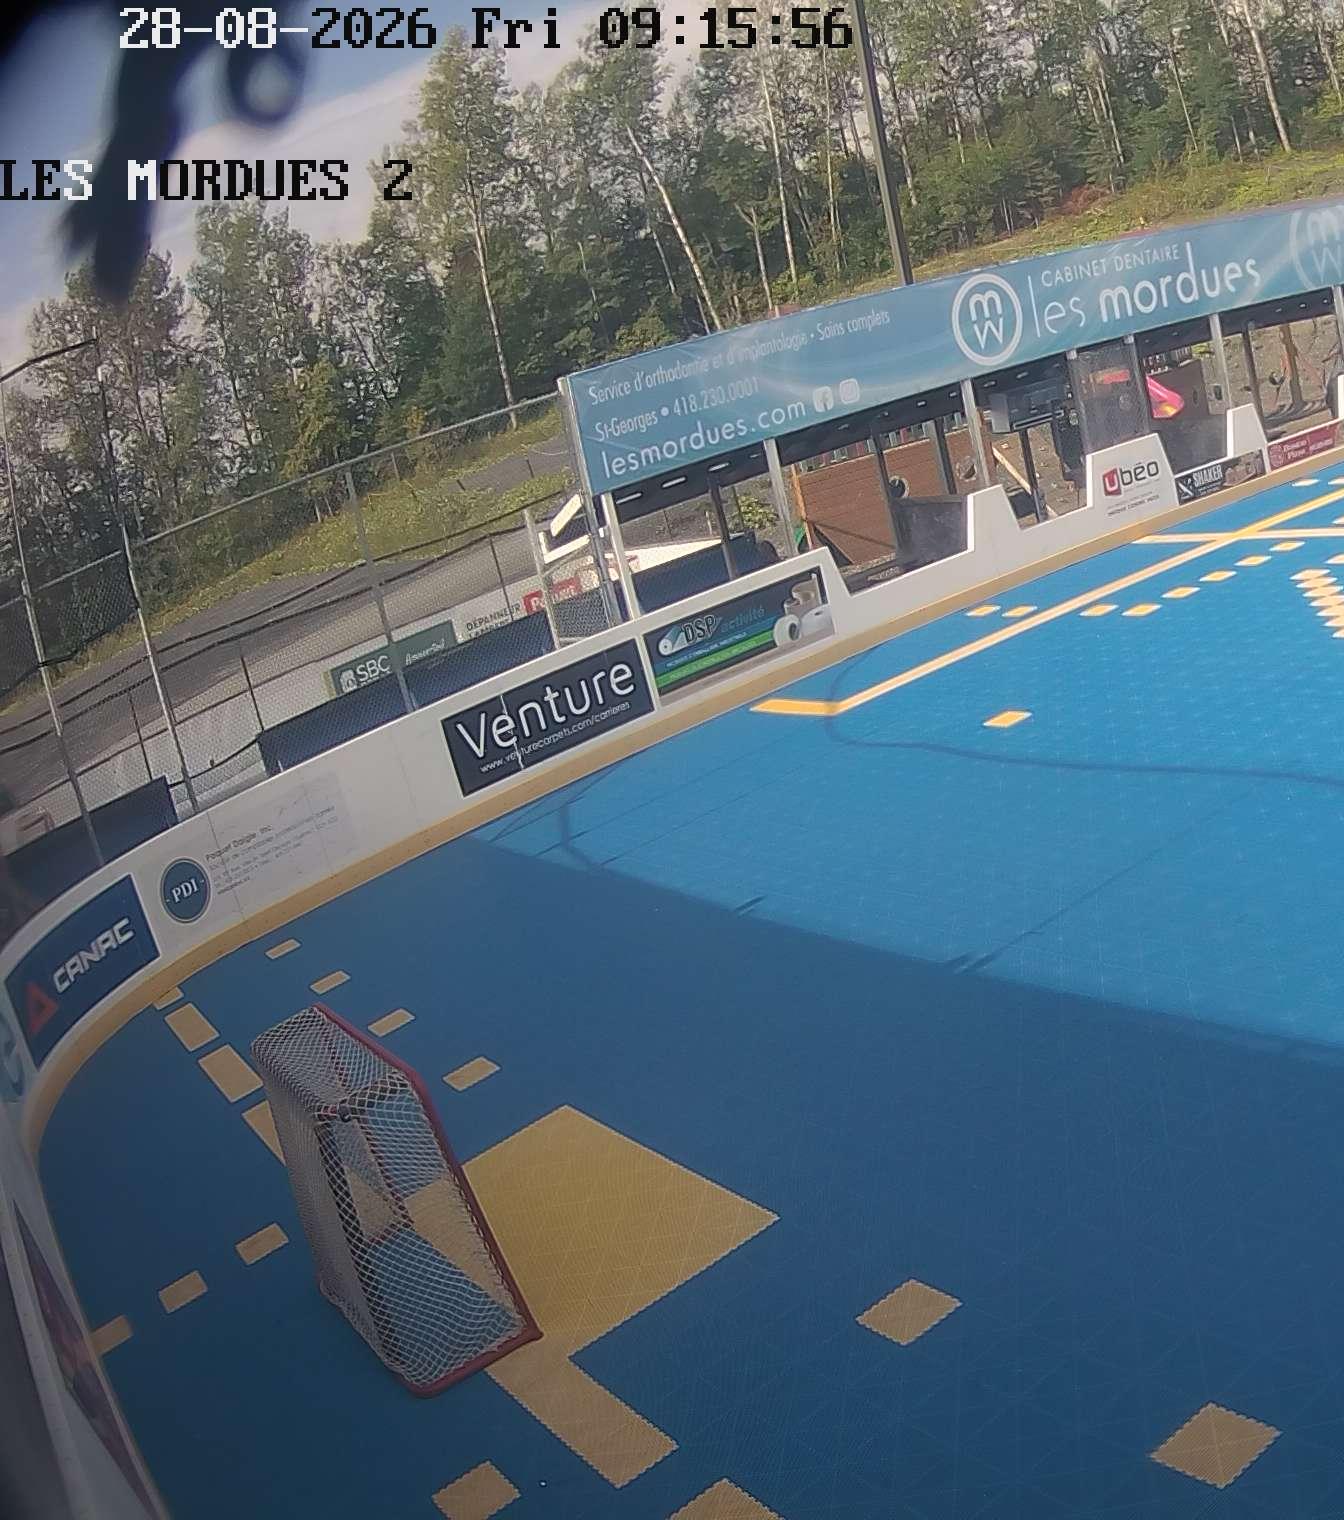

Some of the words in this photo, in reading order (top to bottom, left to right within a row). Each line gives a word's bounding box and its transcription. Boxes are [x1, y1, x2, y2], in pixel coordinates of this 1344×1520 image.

[1040, 257, 1108, 288] CABINET
[1114, 243, 1181, 273] DENTAIRE
[1028, 275, 1086, 338] les
[1099, 242, 1262, 323] mordues
[589, 374, 631, 406] Service
[816, 320, 845, 341] Soins
[847, 310, 891, 335] complets
[596, 408, 658, 442] St-Georges
[601, 400, 807, 479] lesmordues.com
[1193, 464, 1223, 487] SHAKER
[683, 614, 717, 644] DSP
[356, 655, 391, 683] SBC
[456, 663, 635, 759] Venture
[172, 878, 199, 903] PDI
[53, 917, 135, 993] CANAC
